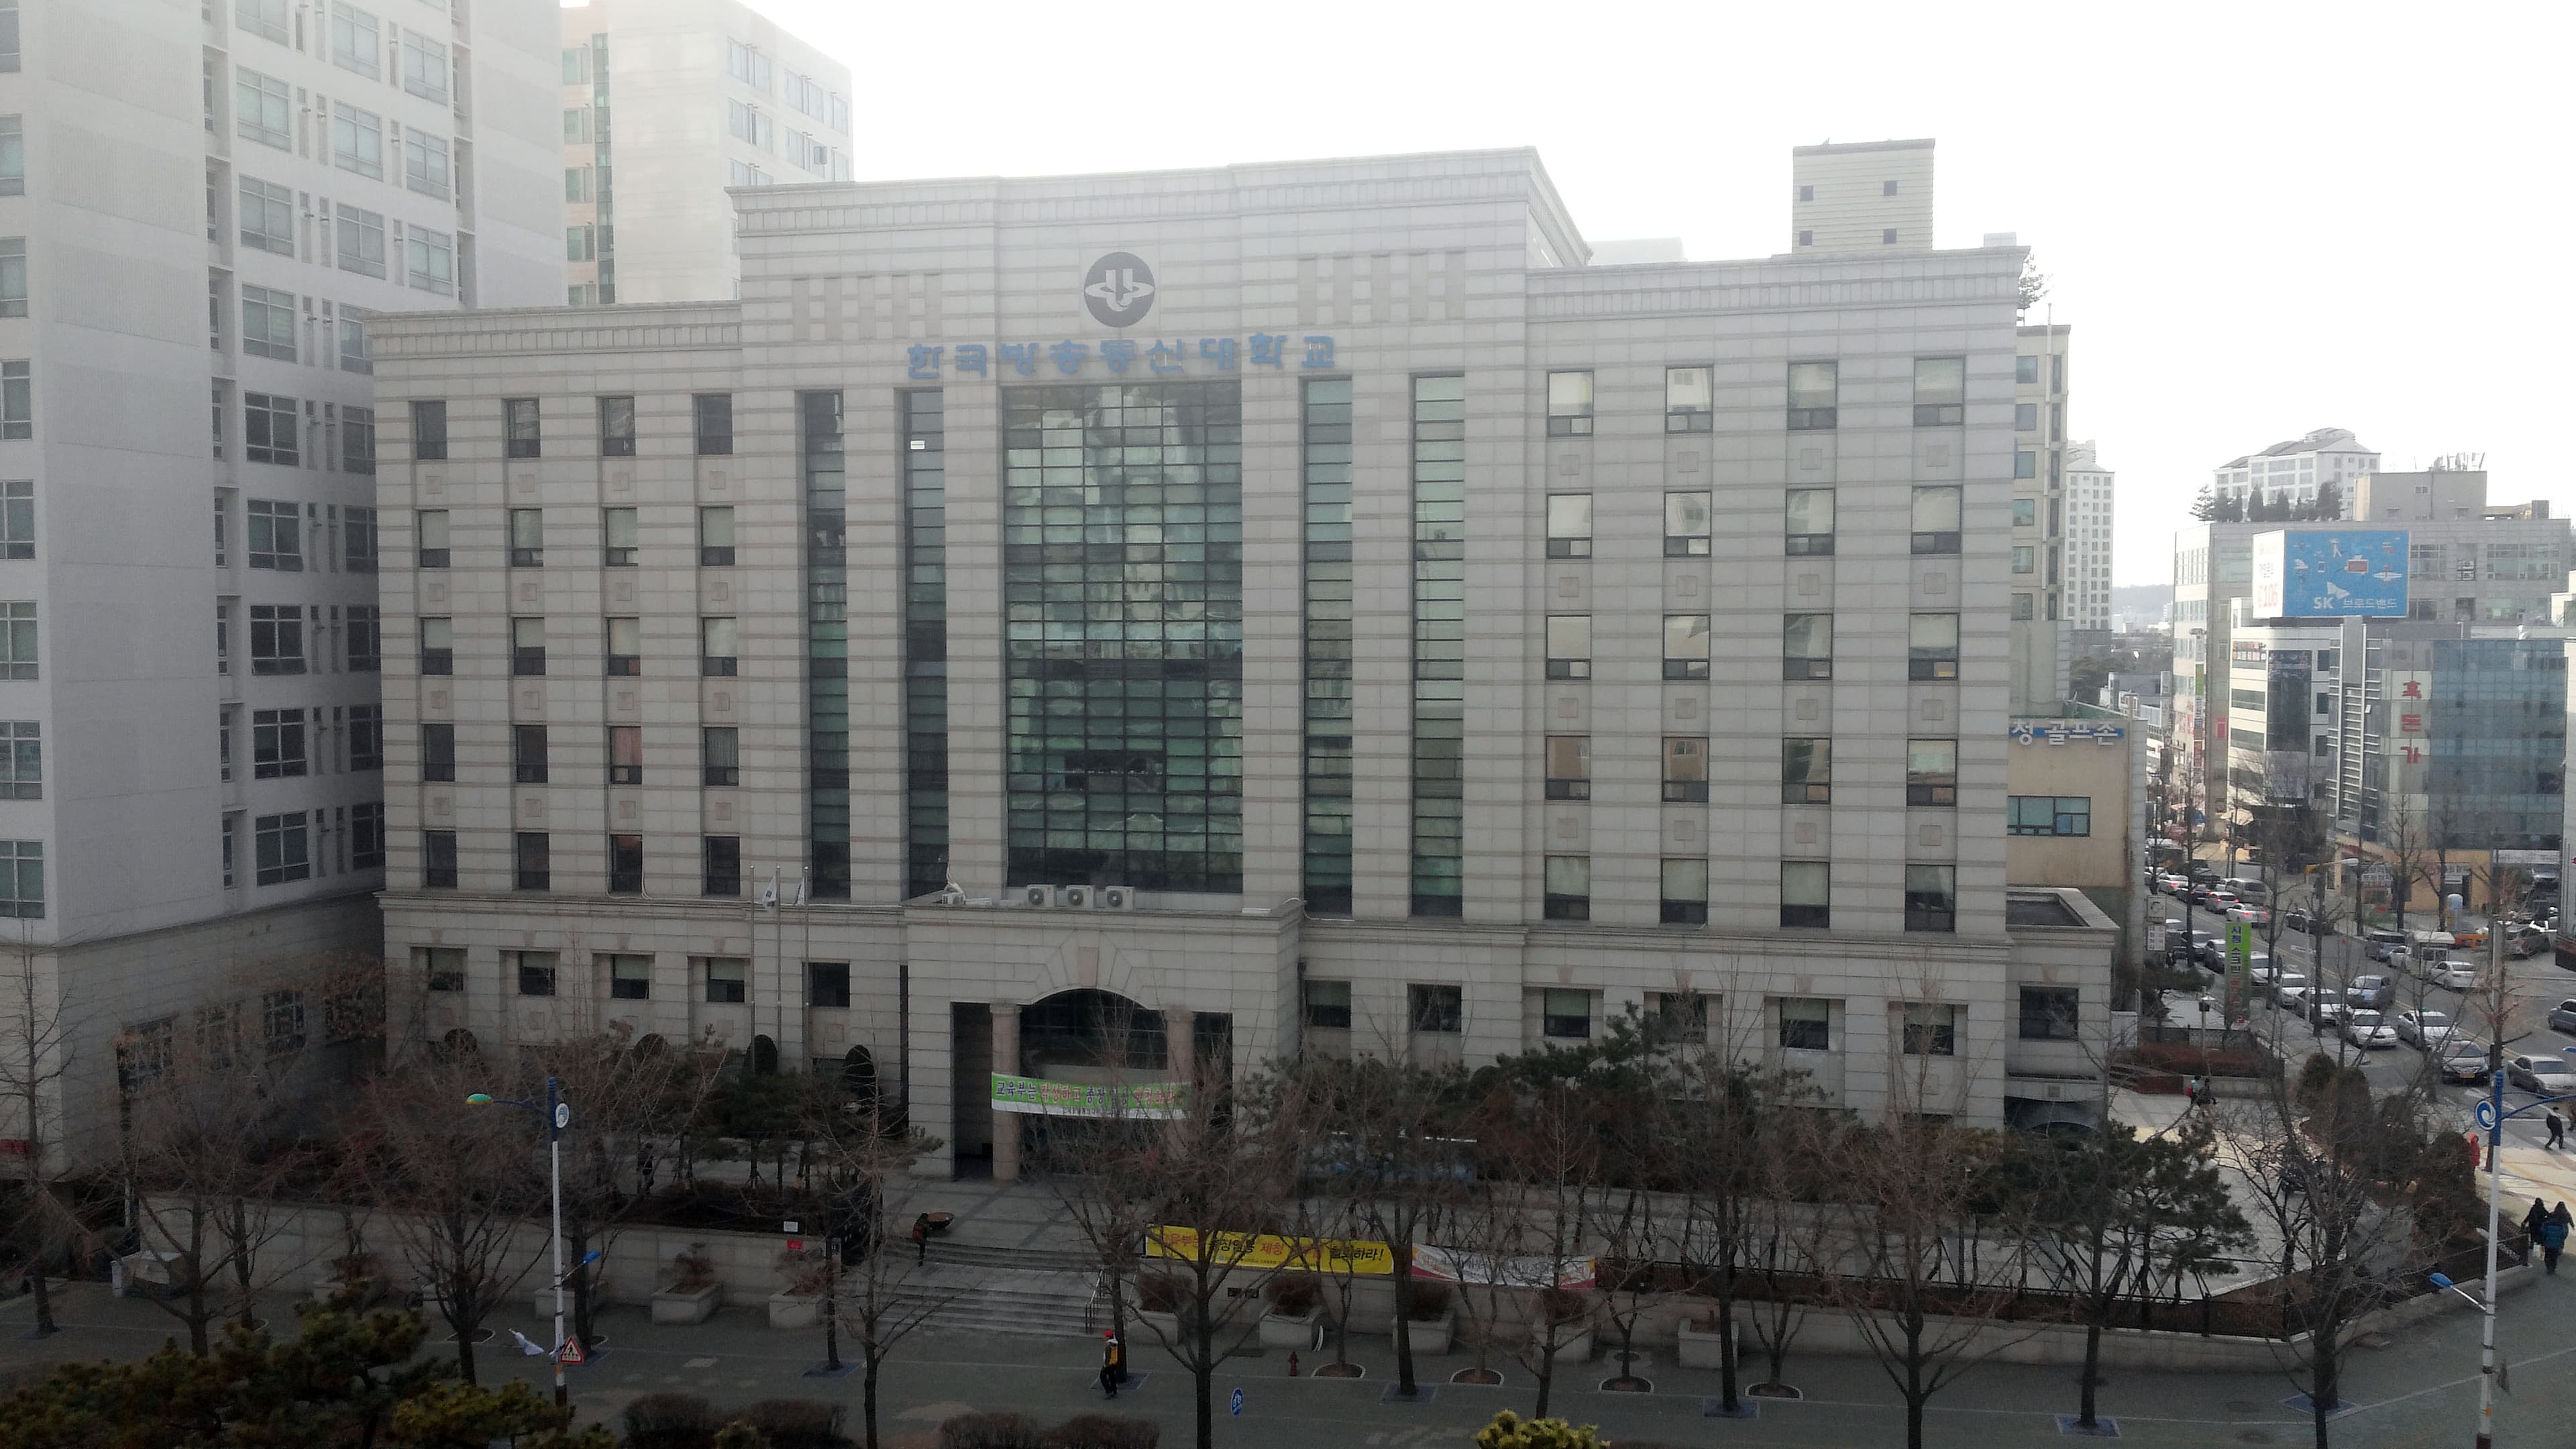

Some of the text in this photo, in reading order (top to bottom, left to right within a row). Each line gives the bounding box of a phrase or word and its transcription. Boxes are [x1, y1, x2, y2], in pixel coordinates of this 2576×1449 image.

[907, 333, 1335, 380] 한국방송통신대학교
[2313, 596, 2398, 610] SK 브로드밴드
[2044, 720, 2118, 746] 골프존
[2400, 680, 2422, 764] 흑돈가
[996, 1080, 1037, 1100] 교육부는
[1040, 1082, 1081, 1104] 각성하고
[1260, 1241, 1285, 1256] 제청
